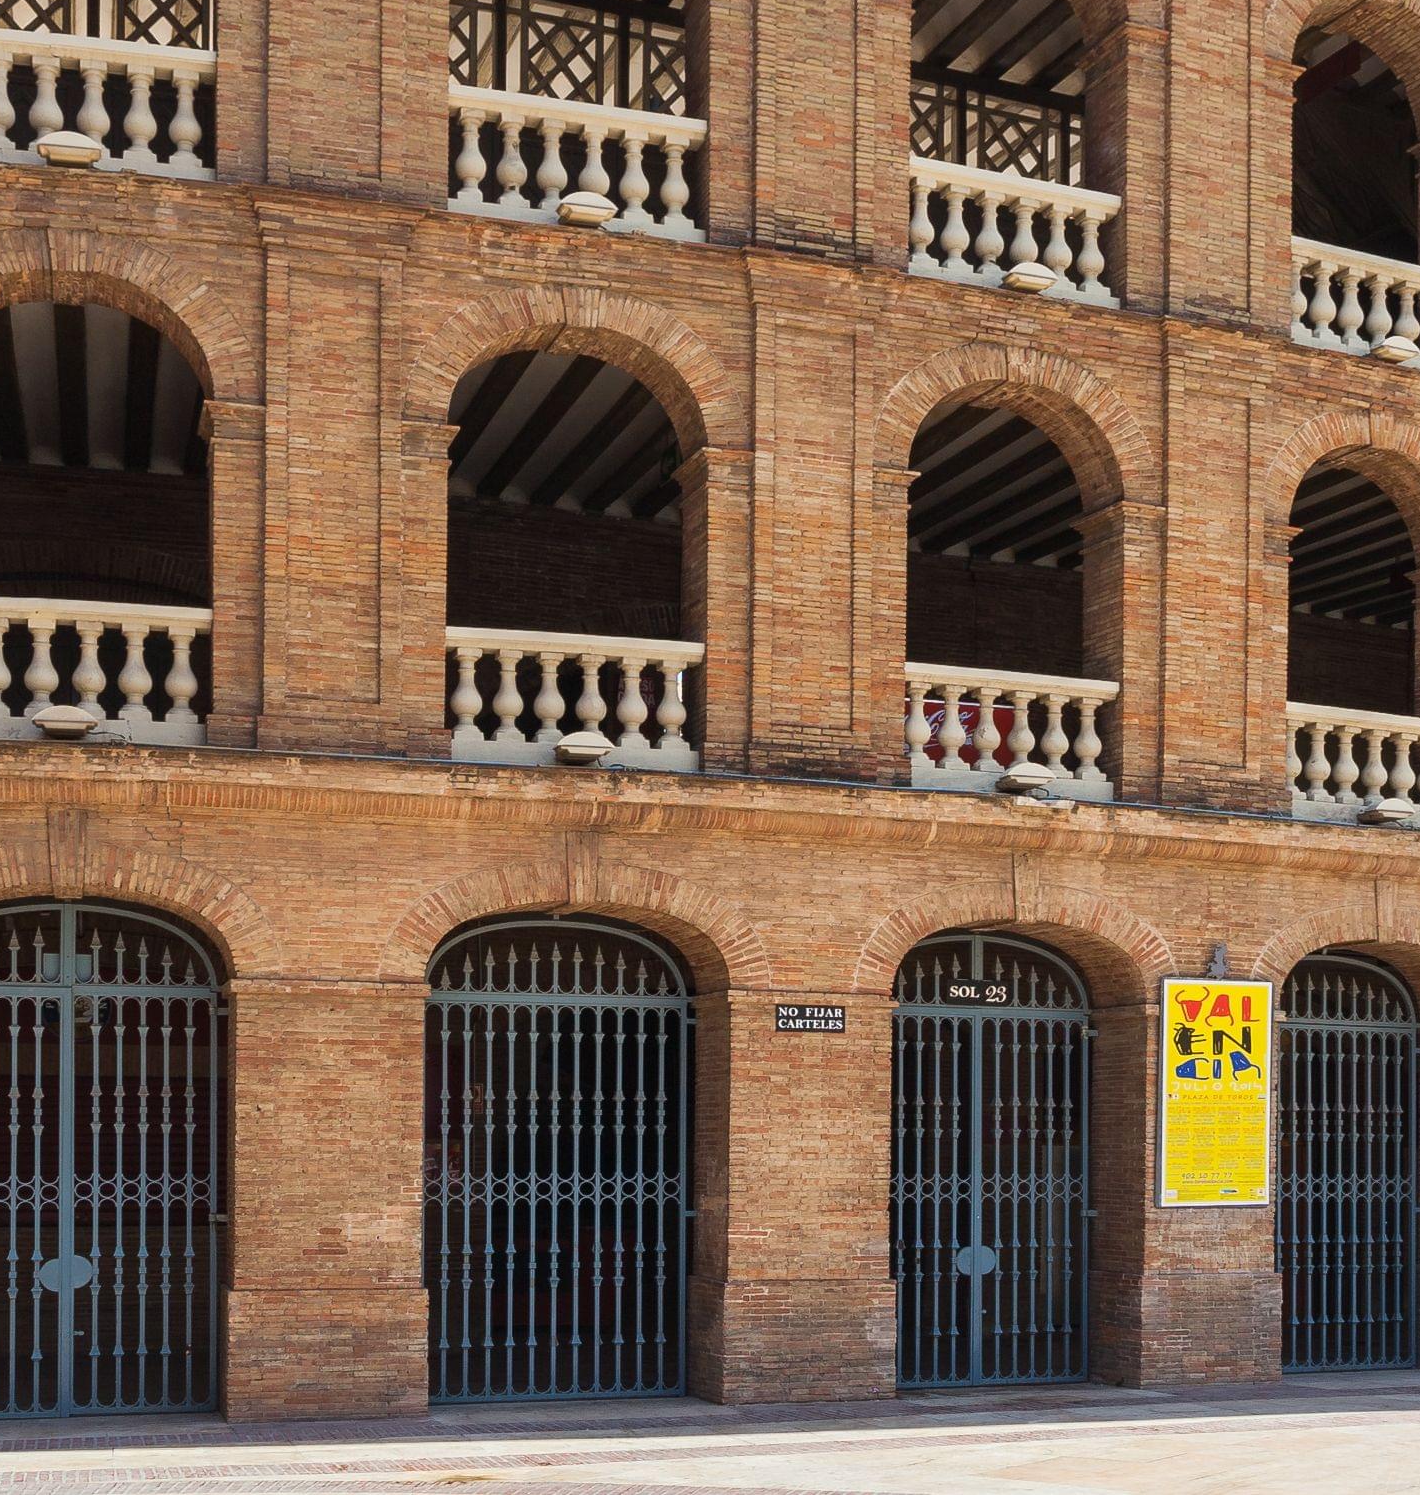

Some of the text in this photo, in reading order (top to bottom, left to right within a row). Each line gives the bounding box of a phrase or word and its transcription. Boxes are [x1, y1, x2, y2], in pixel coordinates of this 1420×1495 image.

[949, 985, 1007, 1003] SOL 23
[778, 1006, 843, 1018] NO FIJAR
[778, 1018, 844, 1030] CARTELES
